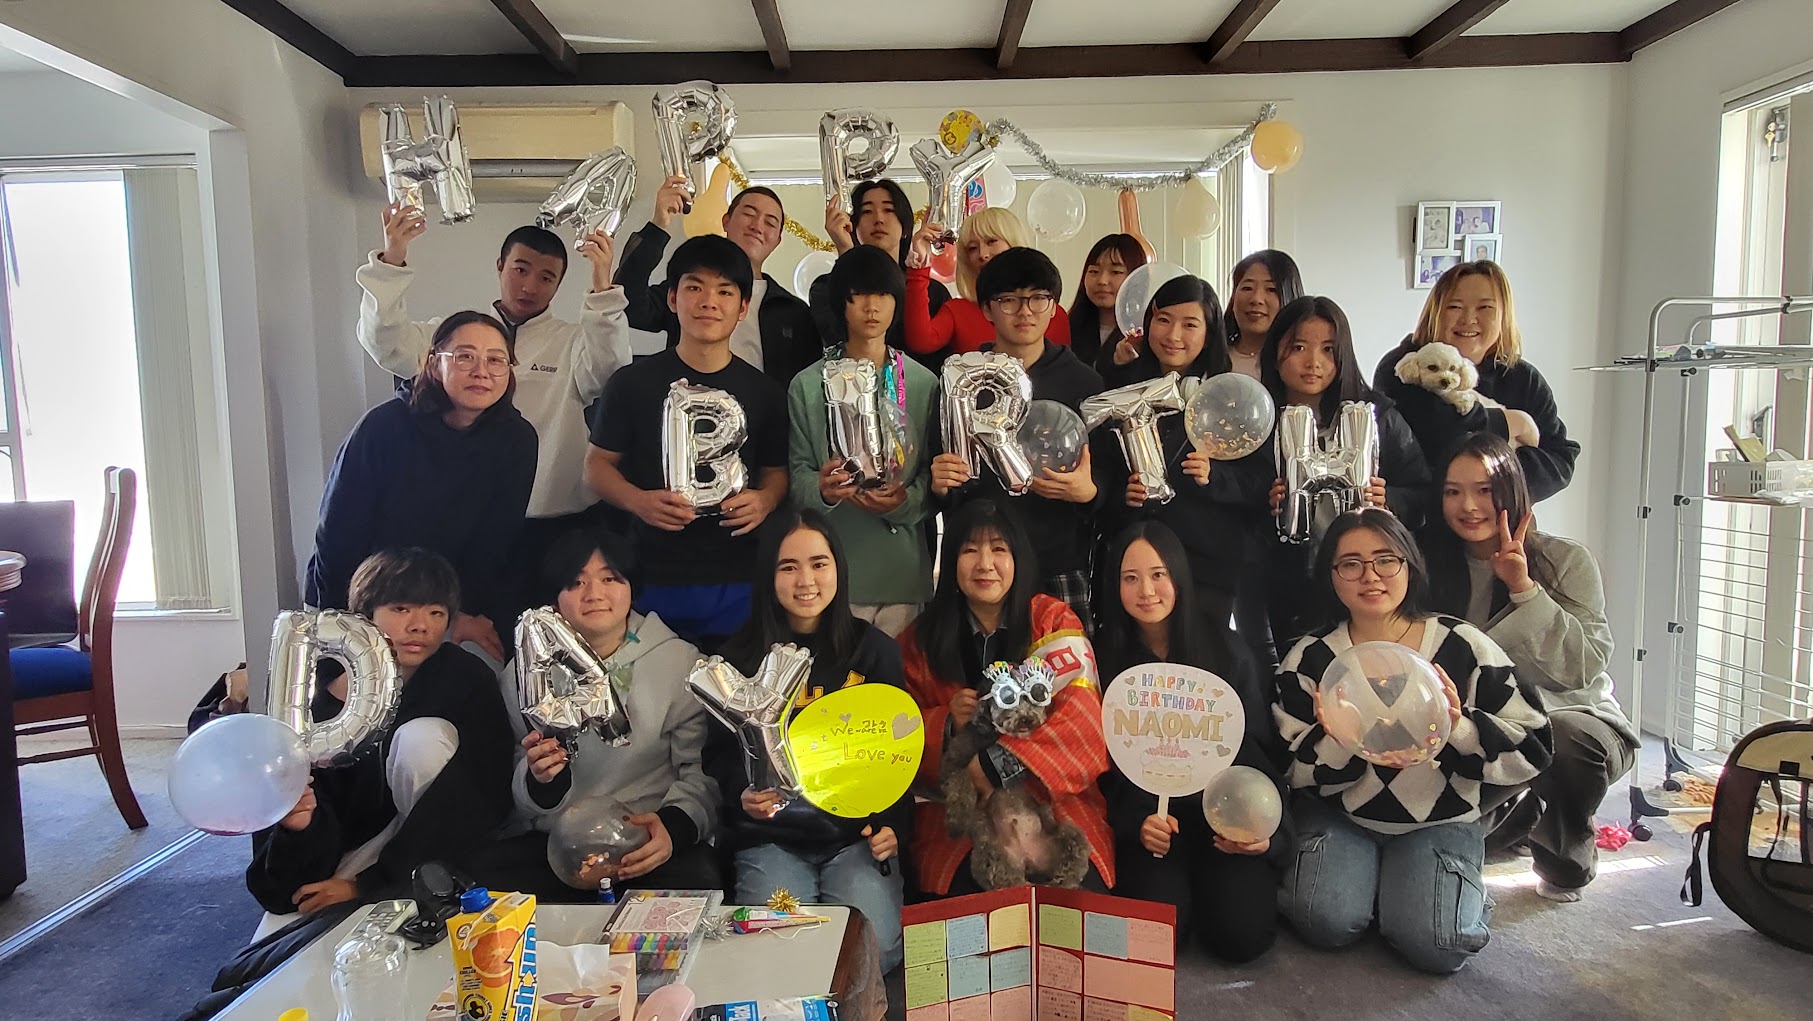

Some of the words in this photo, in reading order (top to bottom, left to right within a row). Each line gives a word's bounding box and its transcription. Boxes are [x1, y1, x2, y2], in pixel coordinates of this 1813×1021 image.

[378, 80, 997, 249] HAPPY
[660, 351, 1380, 544] BIRTH
[1141, 673, 1198, 693] HAPPY
[266, 605, 813, 812] DAY
[1127, 689, 1216, 712] BIRTHDAY
[830, 722, 854, 737] We
[1113, 709, 1224, 742] NAOMI
[843, 742, 886, 761] Love
[890, 752, 912, 765] you
